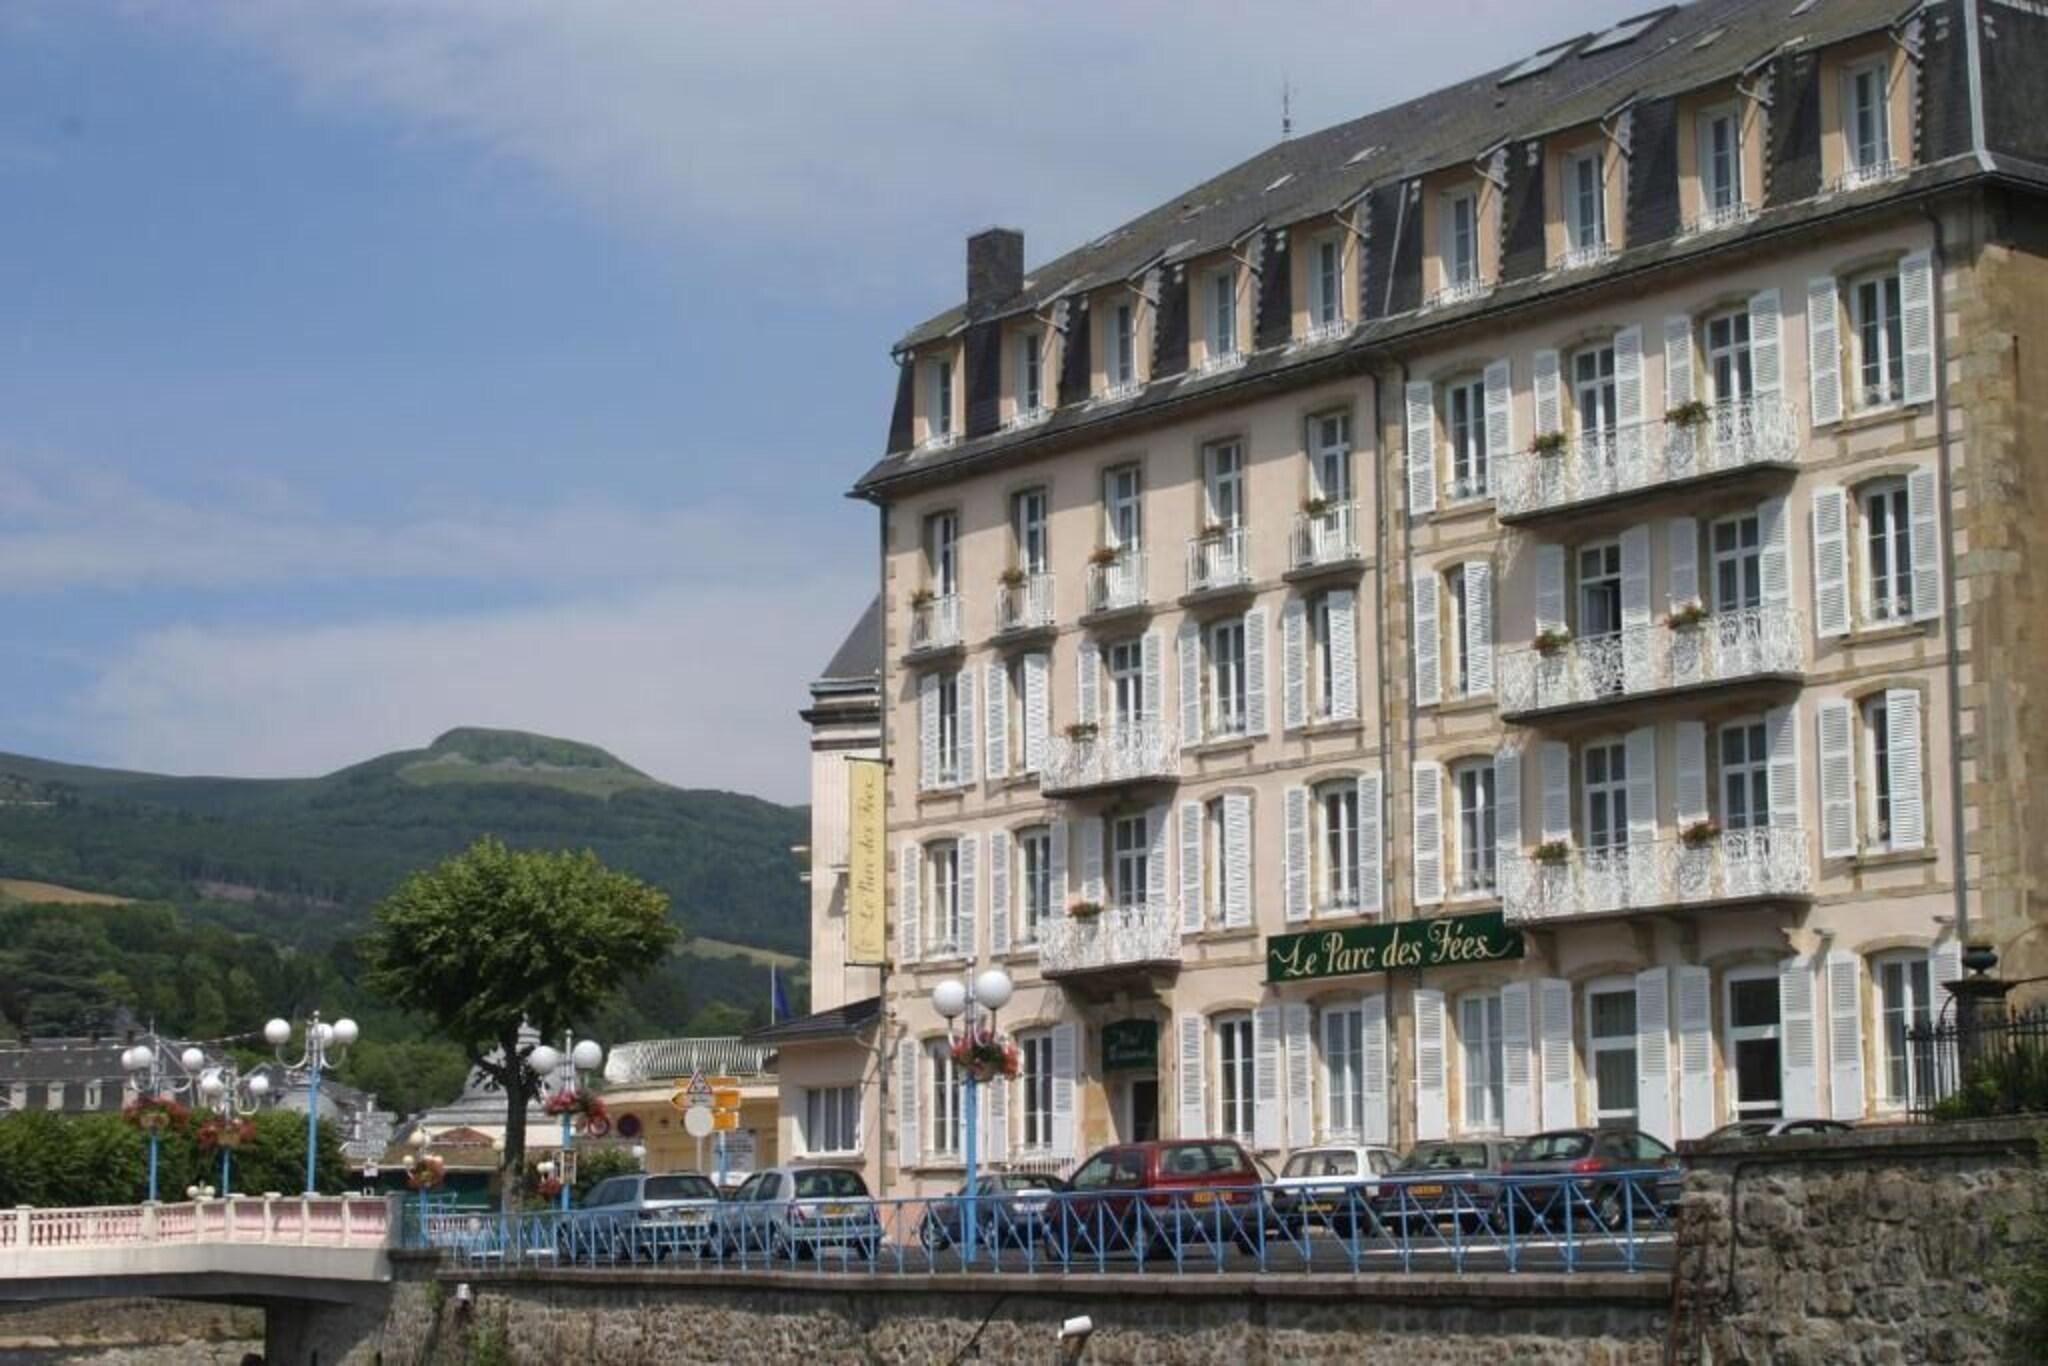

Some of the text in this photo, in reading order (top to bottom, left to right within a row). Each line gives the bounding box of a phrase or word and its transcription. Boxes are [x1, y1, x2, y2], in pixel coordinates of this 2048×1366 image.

[1271, 919, 1513, 976] Le Parc des Fées
